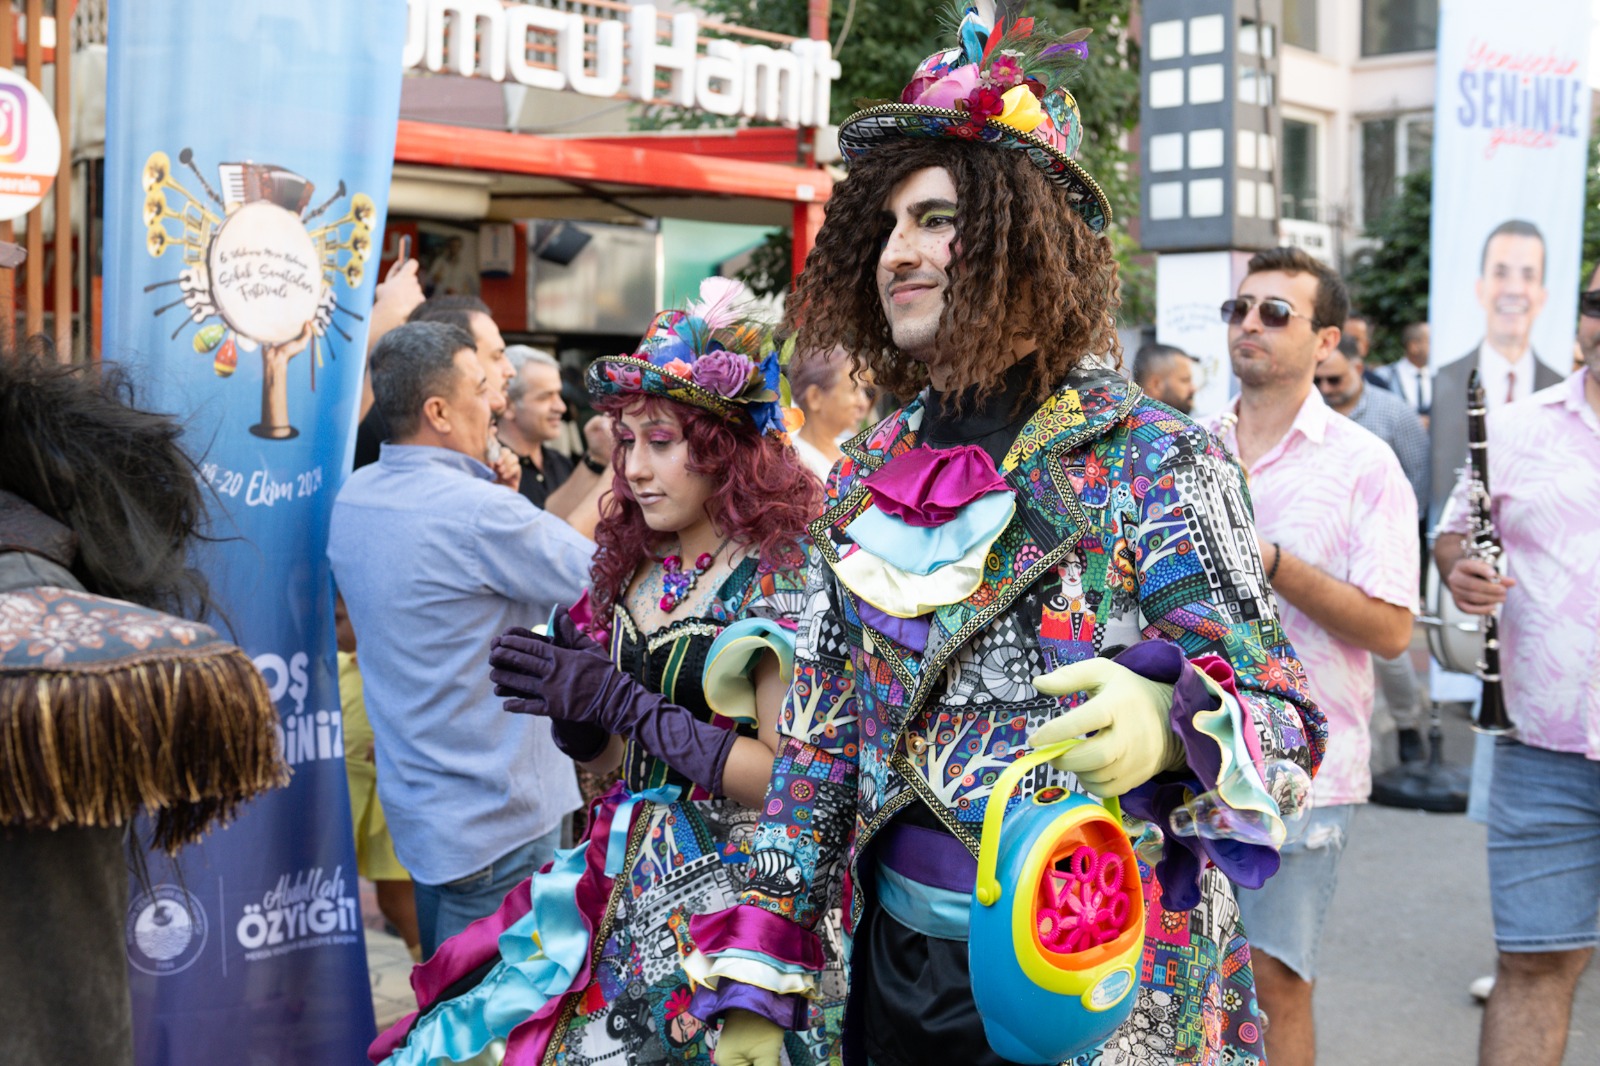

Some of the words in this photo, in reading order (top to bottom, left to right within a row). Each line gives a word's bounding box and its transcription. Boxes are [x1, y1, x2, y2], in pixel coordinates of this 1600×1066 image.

[628, 4, 842, 127] Hamit
[245, 468, 294, 507] Ekim
[252, 651, 310, 715] OŞ
